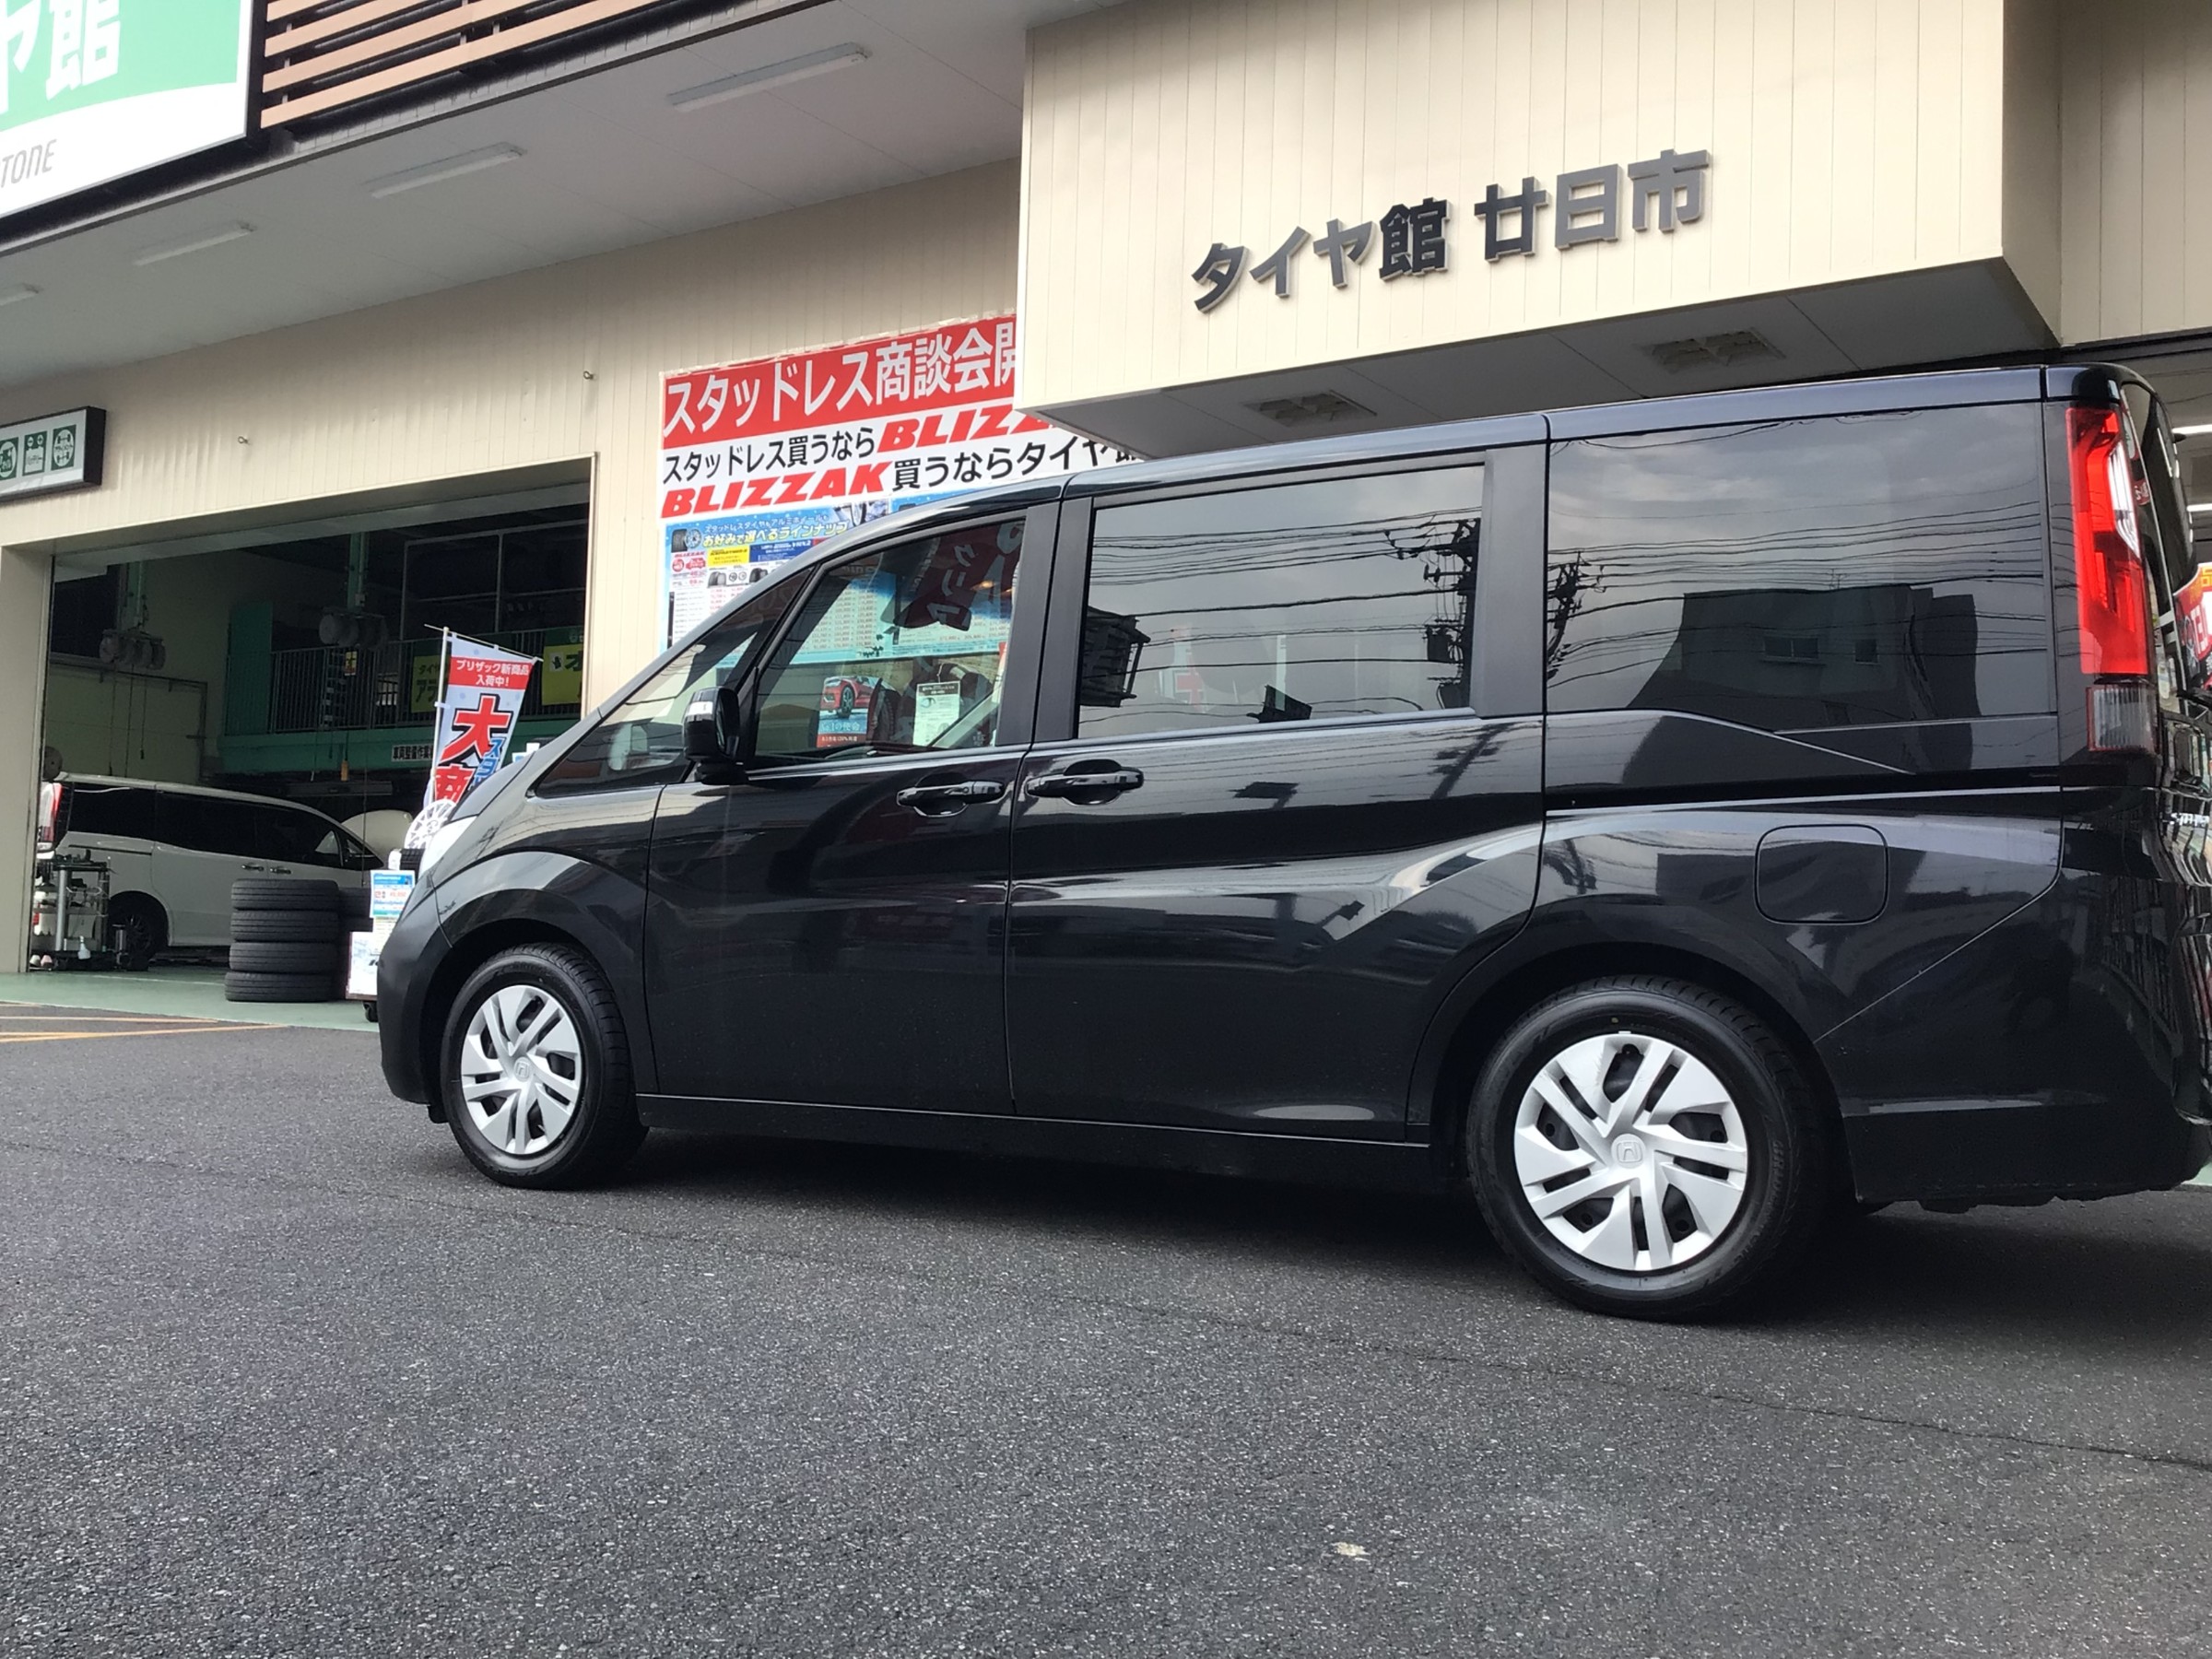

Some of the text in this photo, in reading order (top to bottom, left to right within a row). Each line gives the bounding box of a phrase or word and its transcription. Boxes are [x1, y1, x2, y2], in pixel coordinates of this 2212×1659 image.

[1191, 147, 1711, 312] タイヤ館 廿日市
[456, 660, 530, 676] ブリザック新商品
